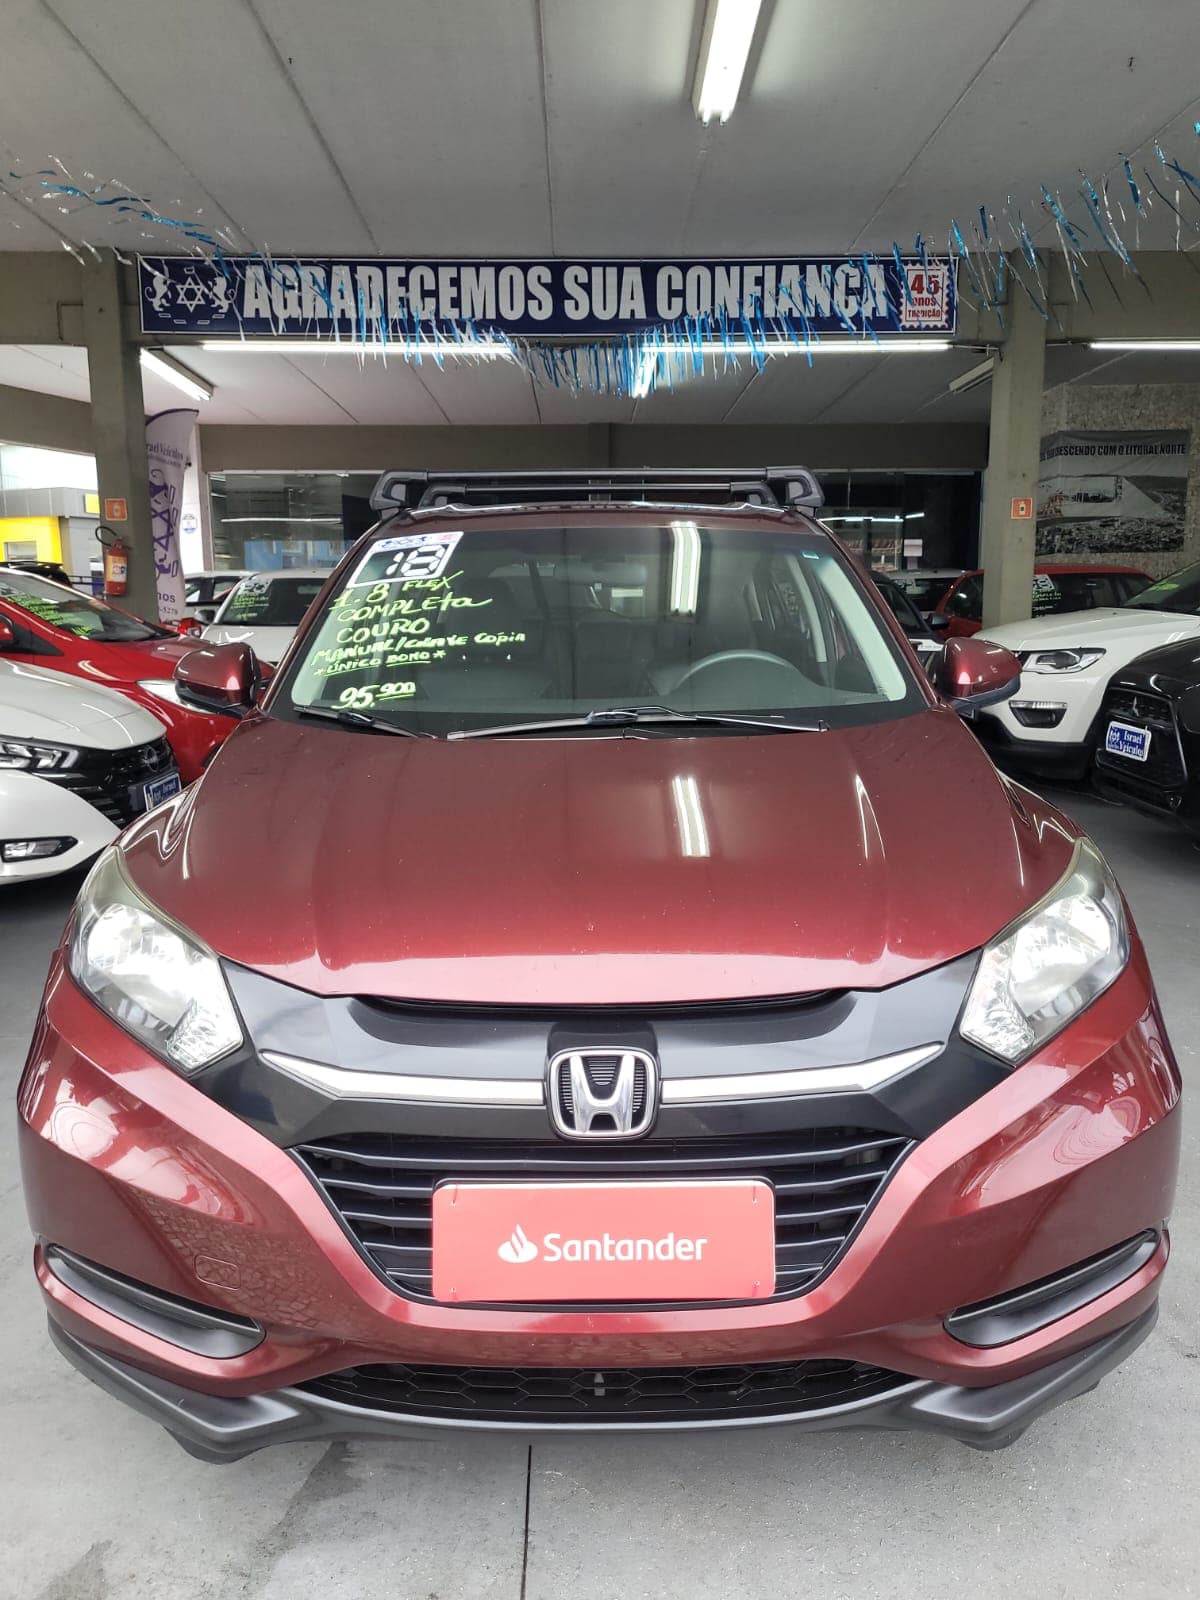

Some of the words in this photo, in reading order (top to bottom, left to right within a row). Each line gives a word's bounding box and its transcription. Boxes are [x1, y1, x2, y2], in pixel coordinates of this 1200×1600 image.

[243, 264, 553, 321] AGRADECEMOS
[564, 264, 647, 321] SUA
[657, 264, 888, 327] CONFIANÇA
[911, 274, 940, 294] 45
[401, 570, 465, 592] FLEX
[336, 617, 430, 643] COURO
[1123, 731, 1142, 744] Israel
[543, 1232, 708, 1262] Santander
